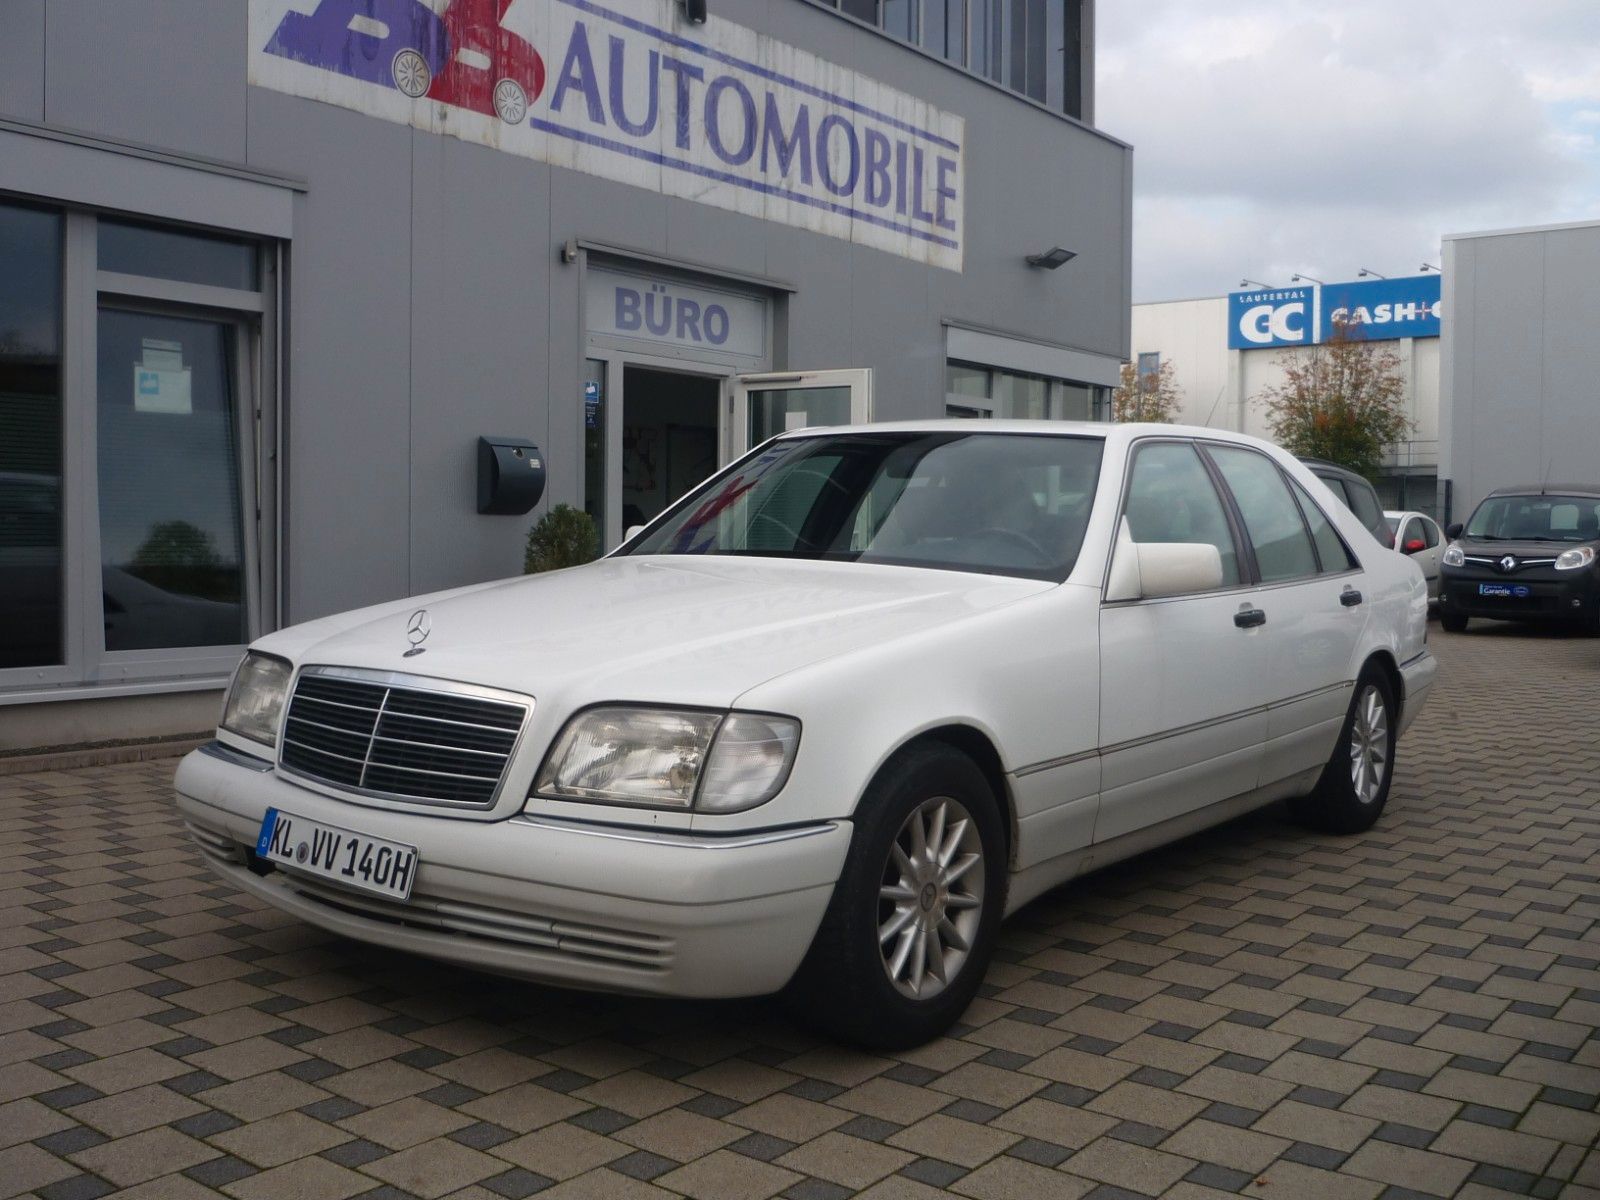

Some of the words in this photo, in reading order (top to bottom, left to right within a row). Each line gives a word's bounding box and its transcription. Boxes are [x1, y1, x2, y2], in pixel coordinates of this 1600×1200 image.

[550, 21, 957, 231] AUTOMOBILE
[615, 284, 729, 345] BÜRO
[1239, 302, 1304, 343] GC
[1240, 291, 1305, 303] LAUTERTAL
[269, 816, 292, 858] KL
[310, 828, 341, 870] VV
[342, 838, 412, 891] 140H
